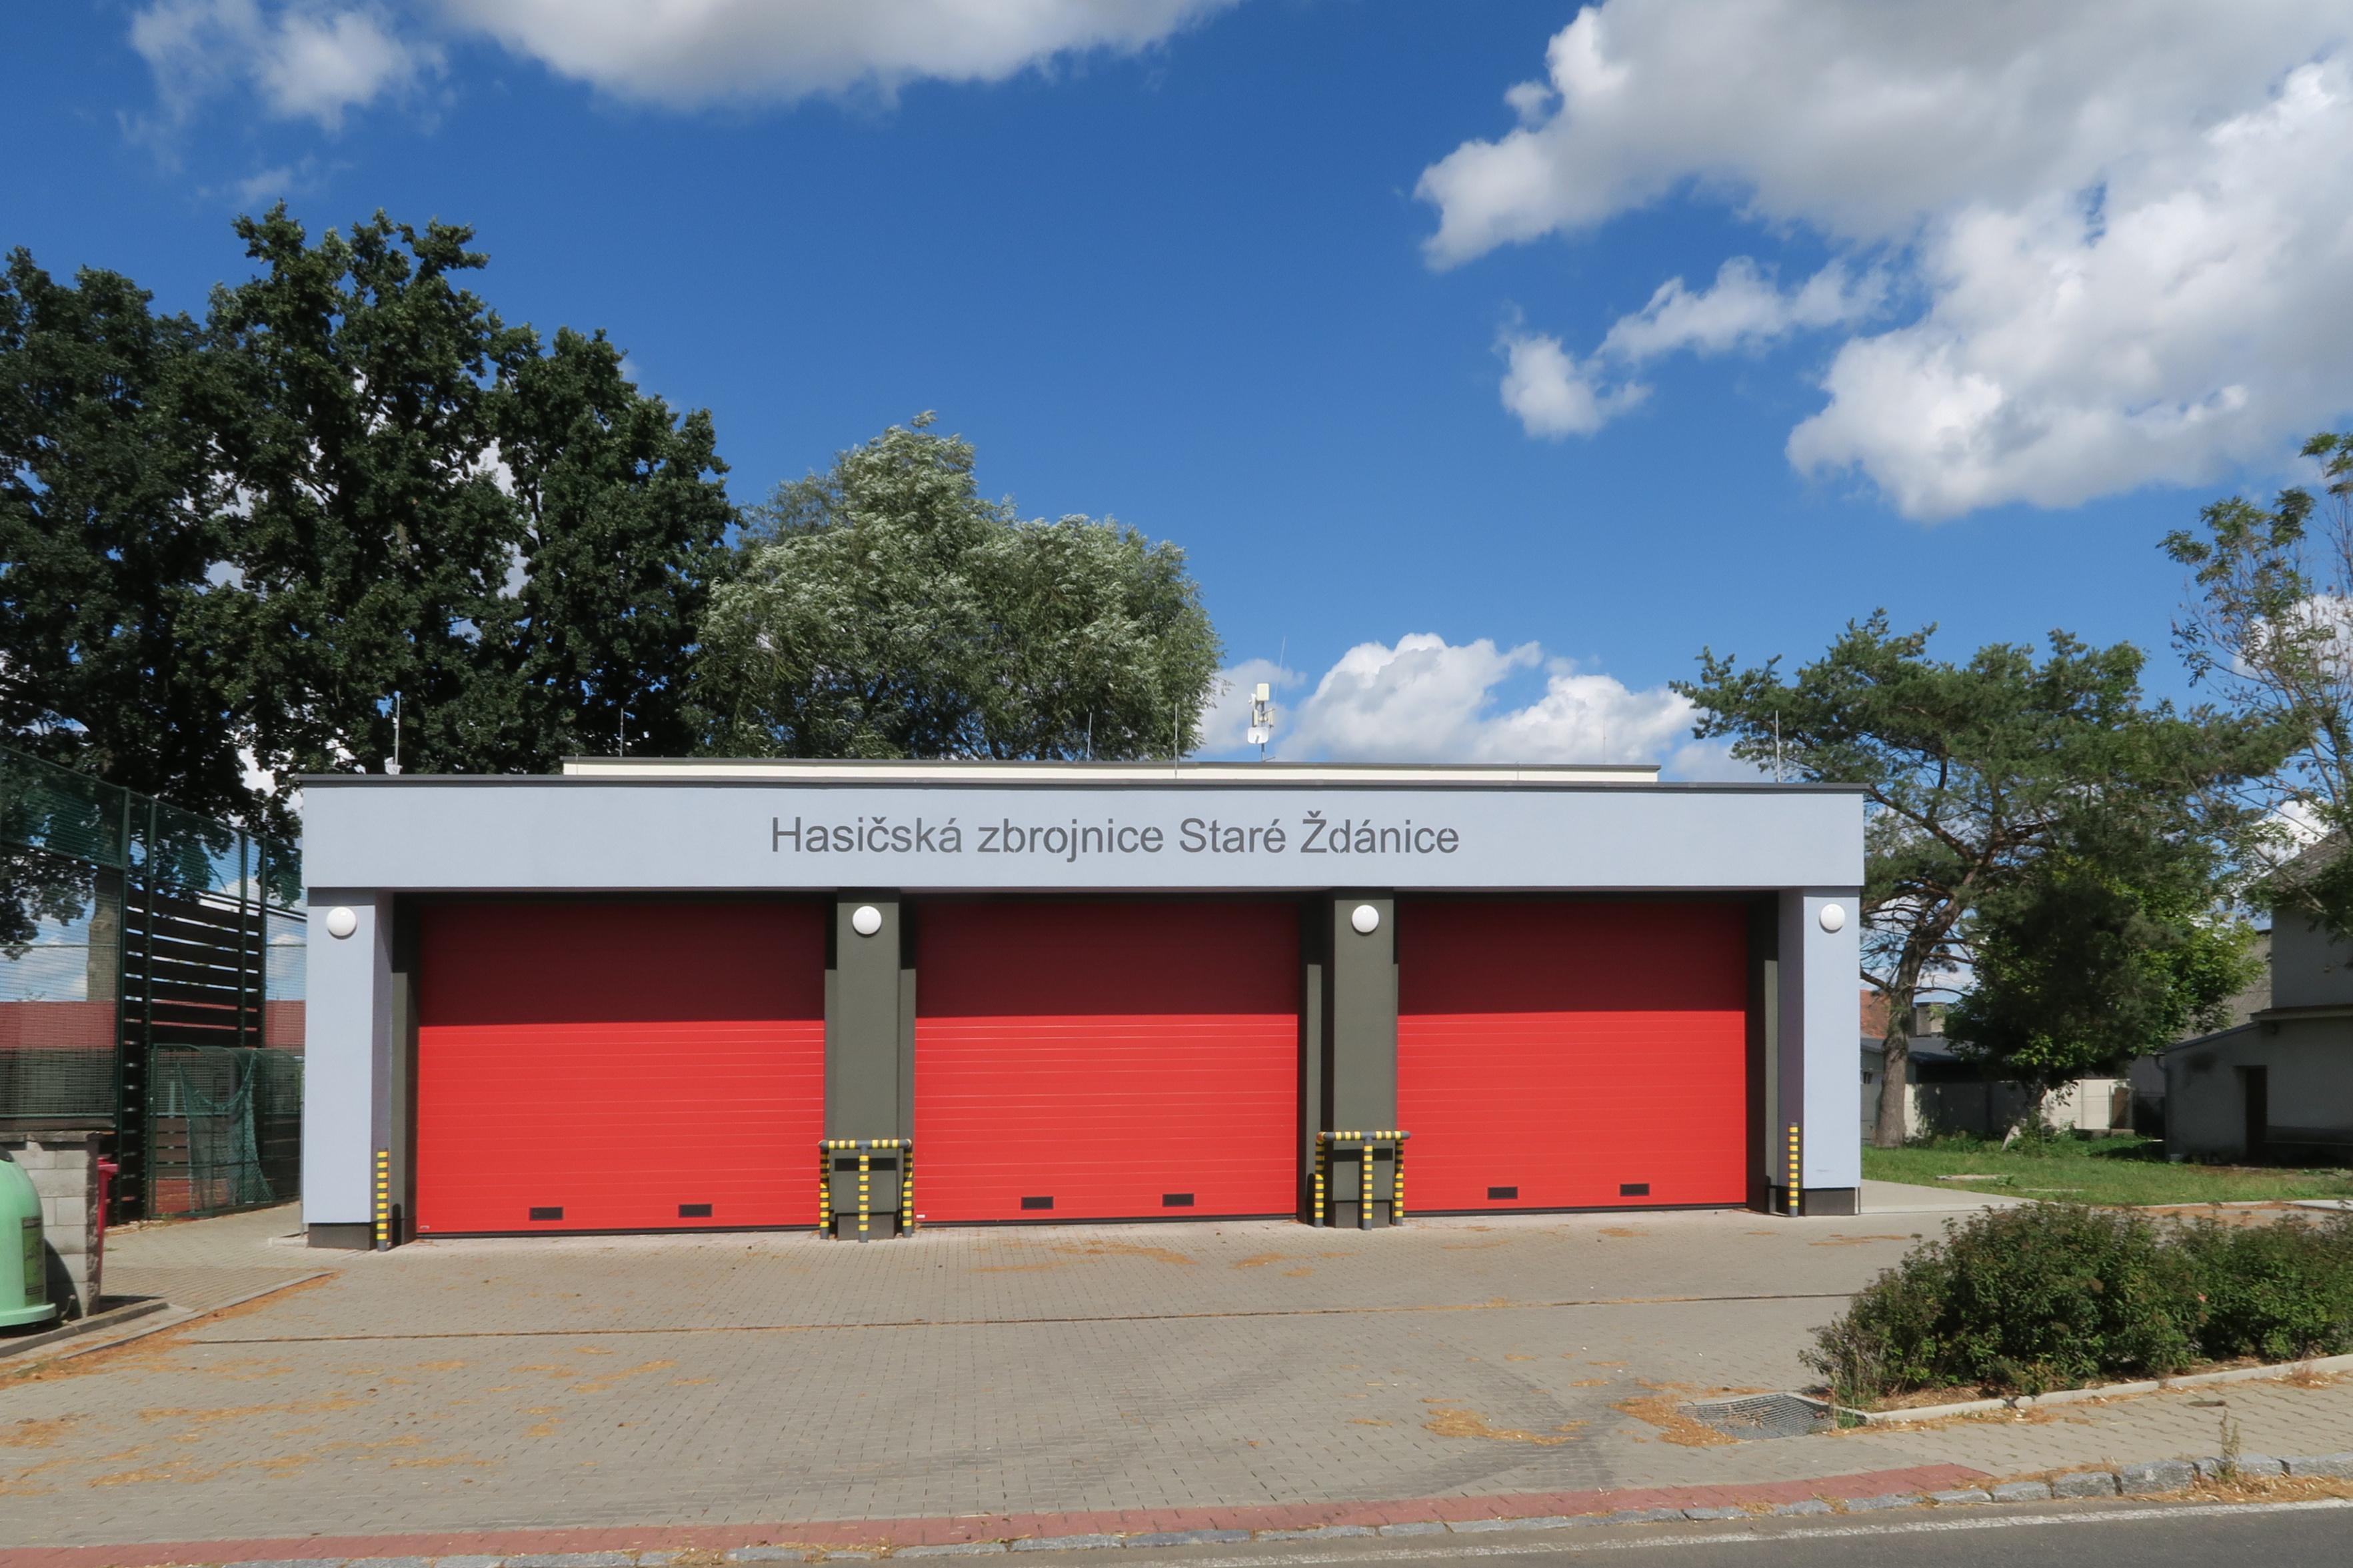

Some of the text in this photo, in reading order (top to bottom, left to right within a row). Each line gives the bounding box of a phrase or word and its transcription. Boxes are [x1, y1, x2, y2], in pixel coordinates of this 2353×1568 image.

[773, 810, 1459, 862] Hasičská zbrojnice Staré Ždánice
